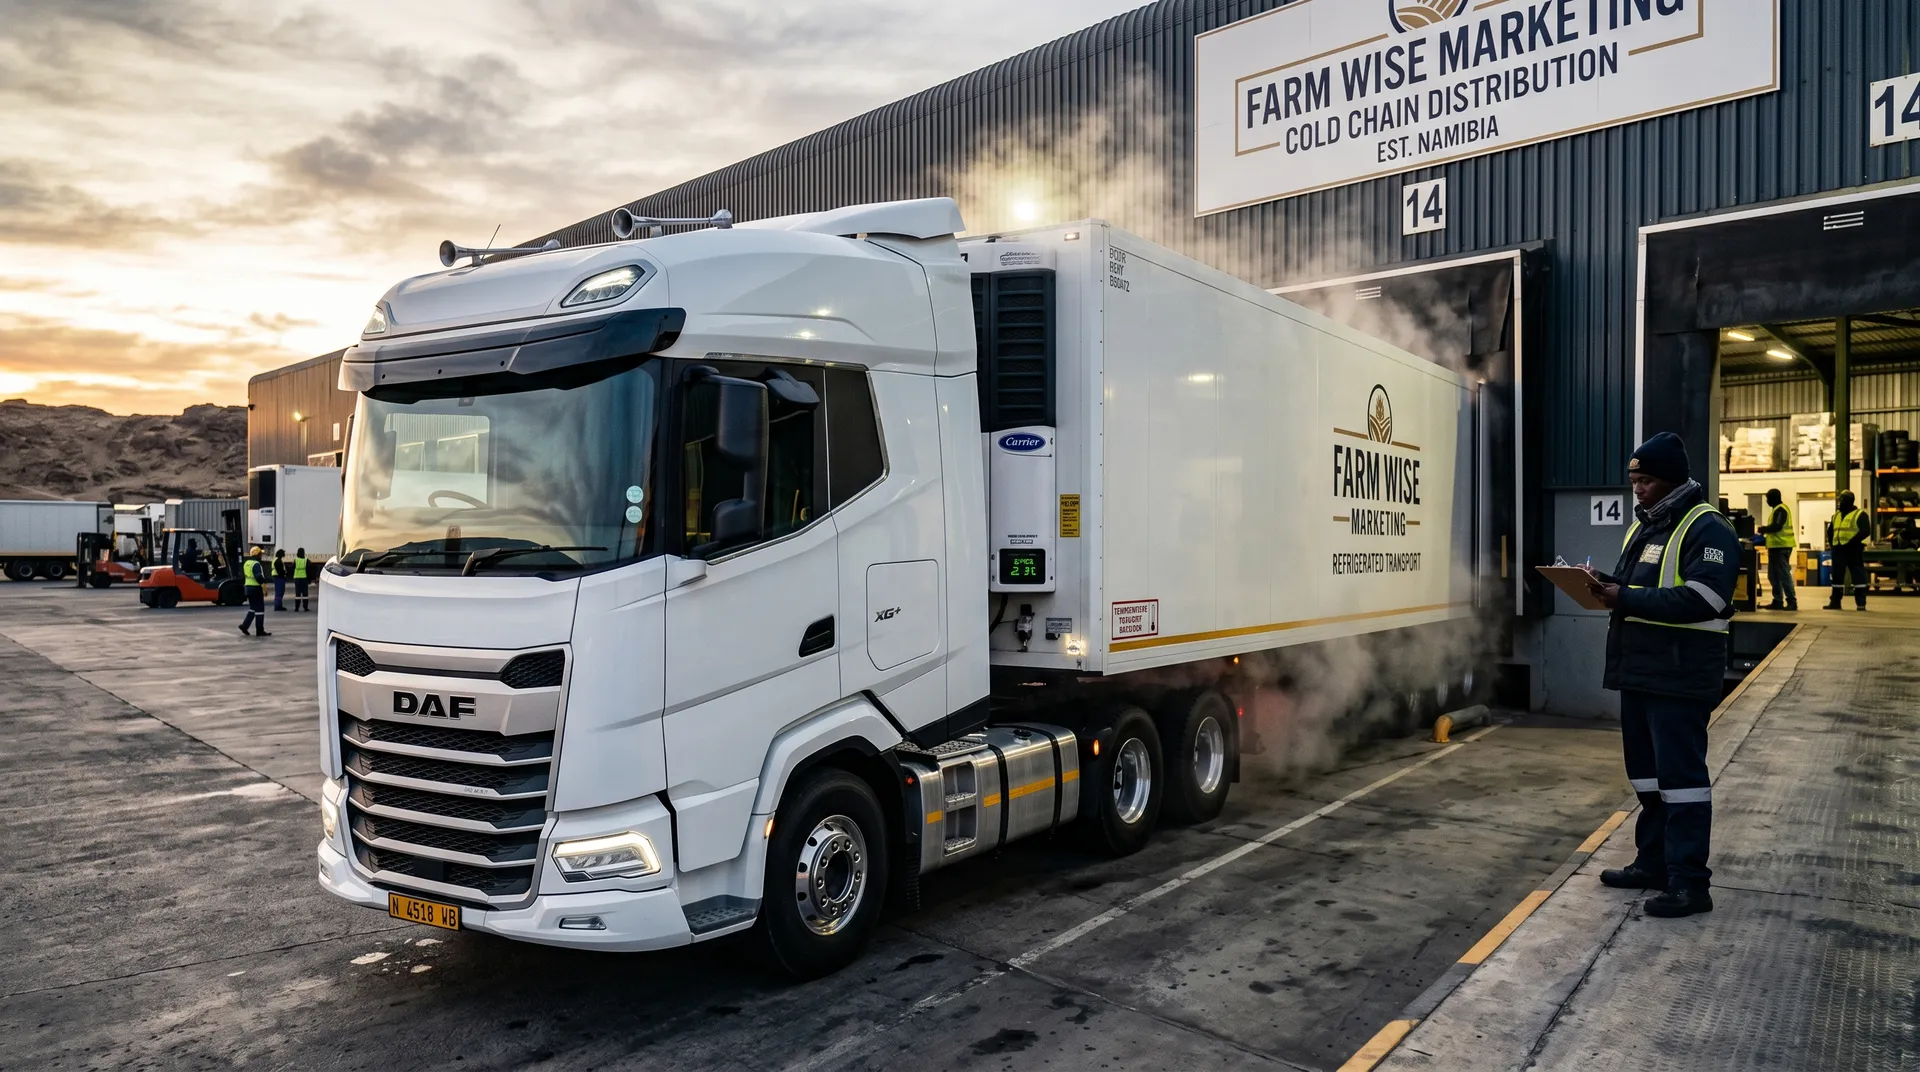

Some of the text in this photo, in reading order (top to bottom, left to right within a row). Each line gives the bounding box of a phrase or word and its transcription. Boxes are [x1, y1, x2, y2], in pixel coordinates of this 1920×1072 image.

[1247, 66, 1331, 129] FARM
[1341, 37, 1428, 102] WISE
[1285, 41, 1618, 155] COLD CHAIN DISTRIBUTION
[1377, 114, 1499, 163] EST. NAMIBIA
[1406, 183, 1443, 228] 14
[1005, 437, 1040, 446] Carrier
[1333, 444, 1420, 505] FARM WISE
[1351, 507, 1406, 536] MARKETING
[1593, 500, 1621, 521] 14
[1332, 552, 1421, 575] REFRIGERATED TRANSPORT
[874, 606, 902, 622] XG+
[393, 690, 476, 720] DAF
[392, 897, 456, 927] N 4518 WB
